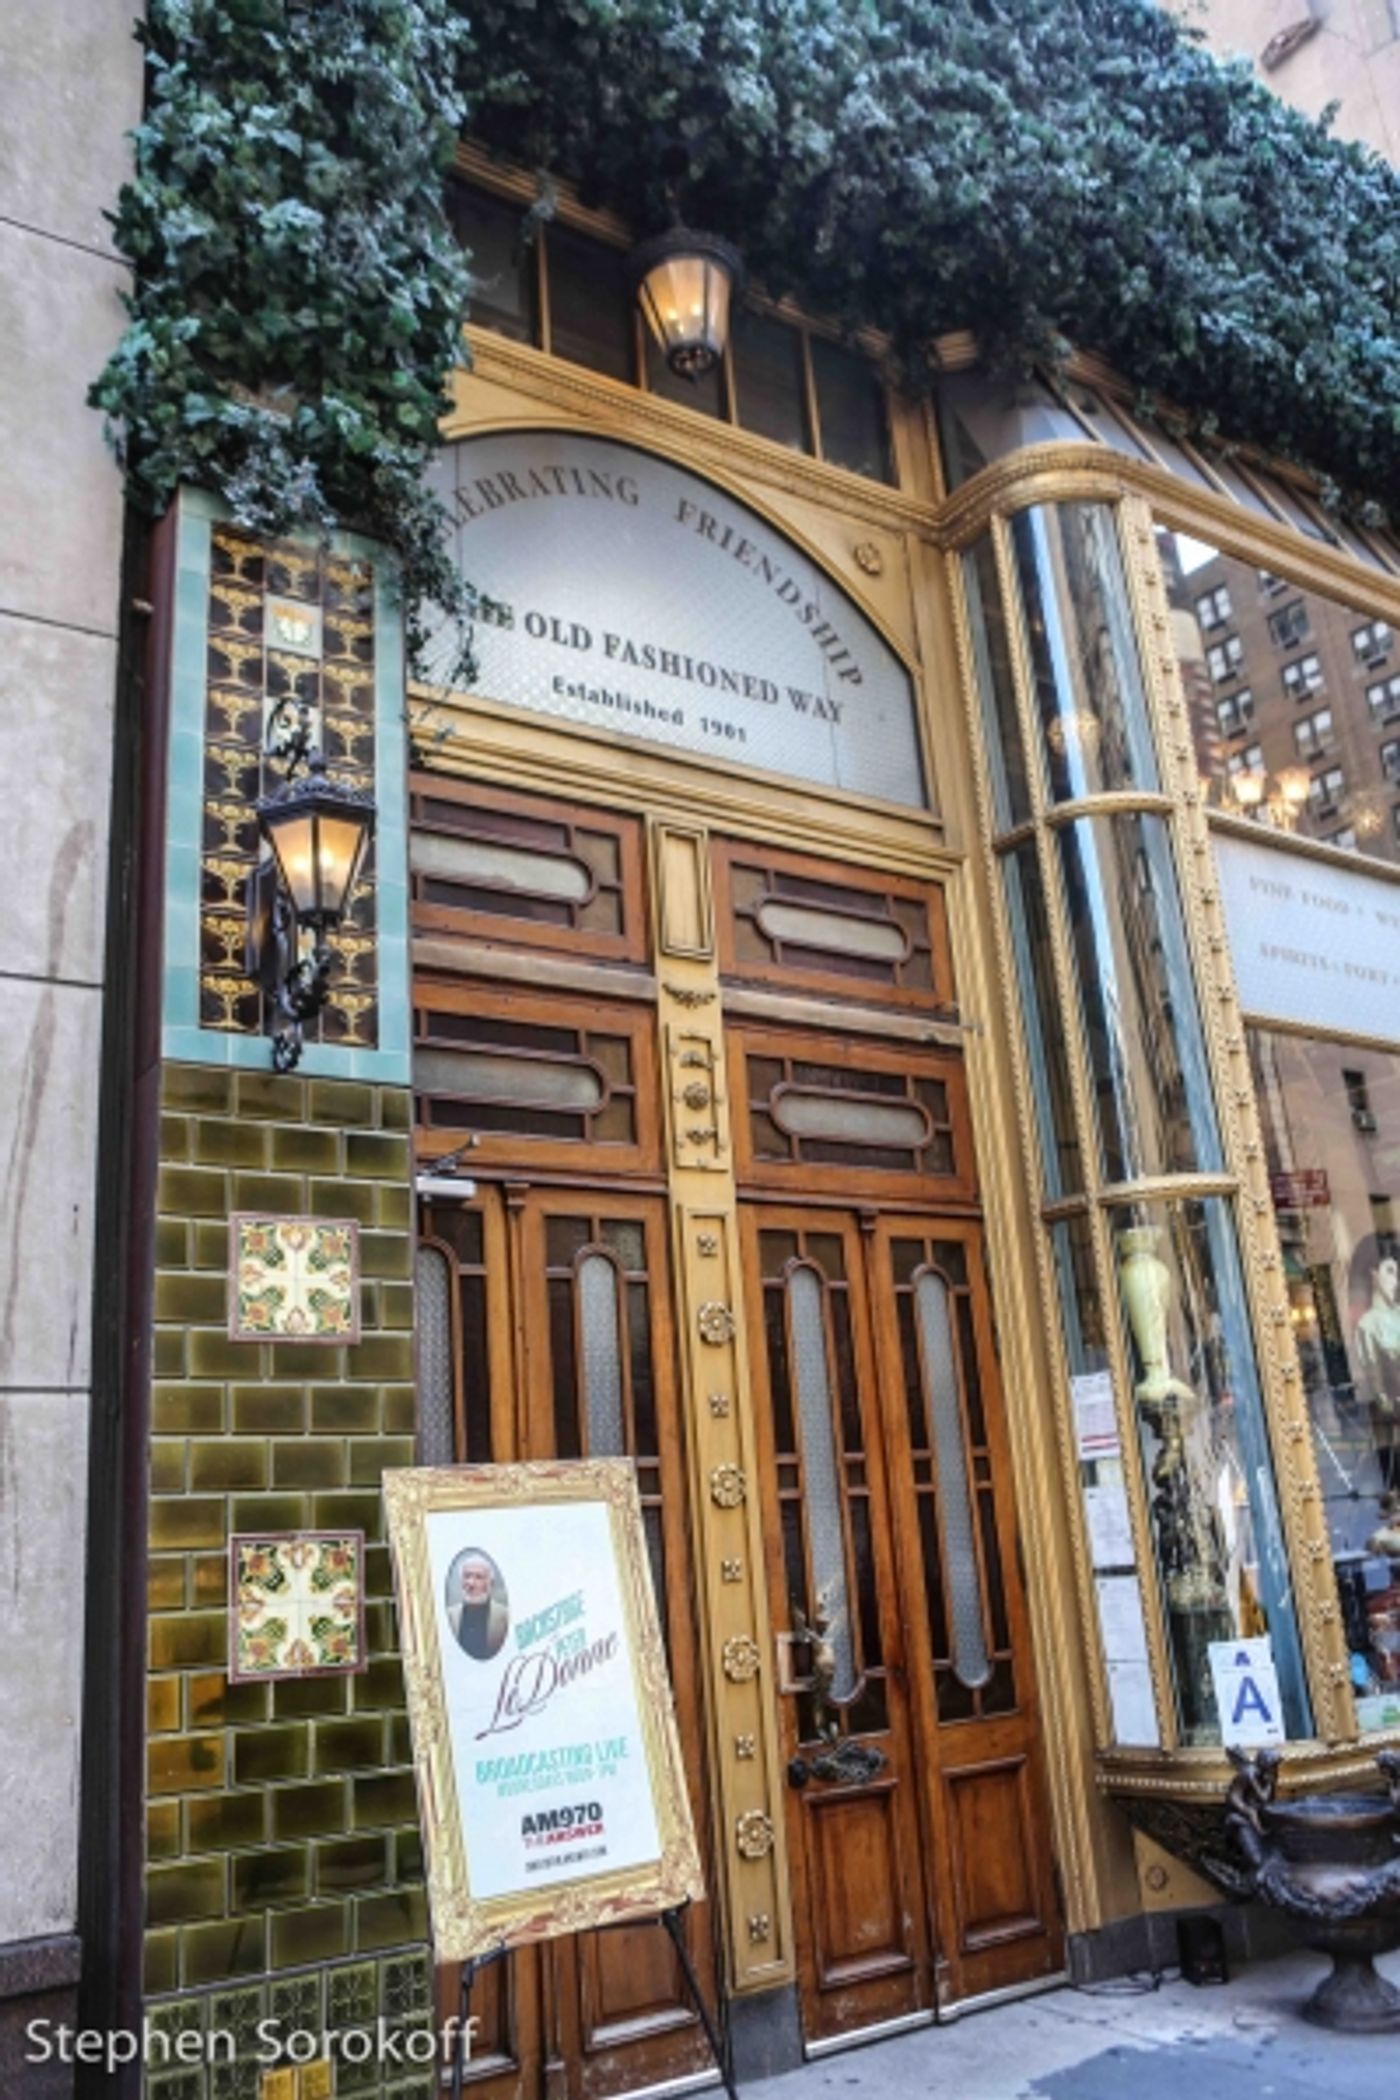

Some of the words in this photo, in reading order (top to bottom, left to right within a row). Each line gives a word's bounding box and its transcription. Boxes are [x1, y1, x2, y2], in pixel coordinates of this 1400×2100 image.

[441, 464, 641, 537] LEBRATING
[674, 496, 864, 687] FRIENDSHIP
[524, 610, 593, 651] OLD
[602, 632, 779, 704] FASHIONED
[786, 685, 844, 725] WAY
[552, 675, 685, 726] Established
[1232, 1676, 1273, 1724] A
[475, 1743, 594, 1784] BROADCASTING
[521, 1801, 603, 1836] AM970
